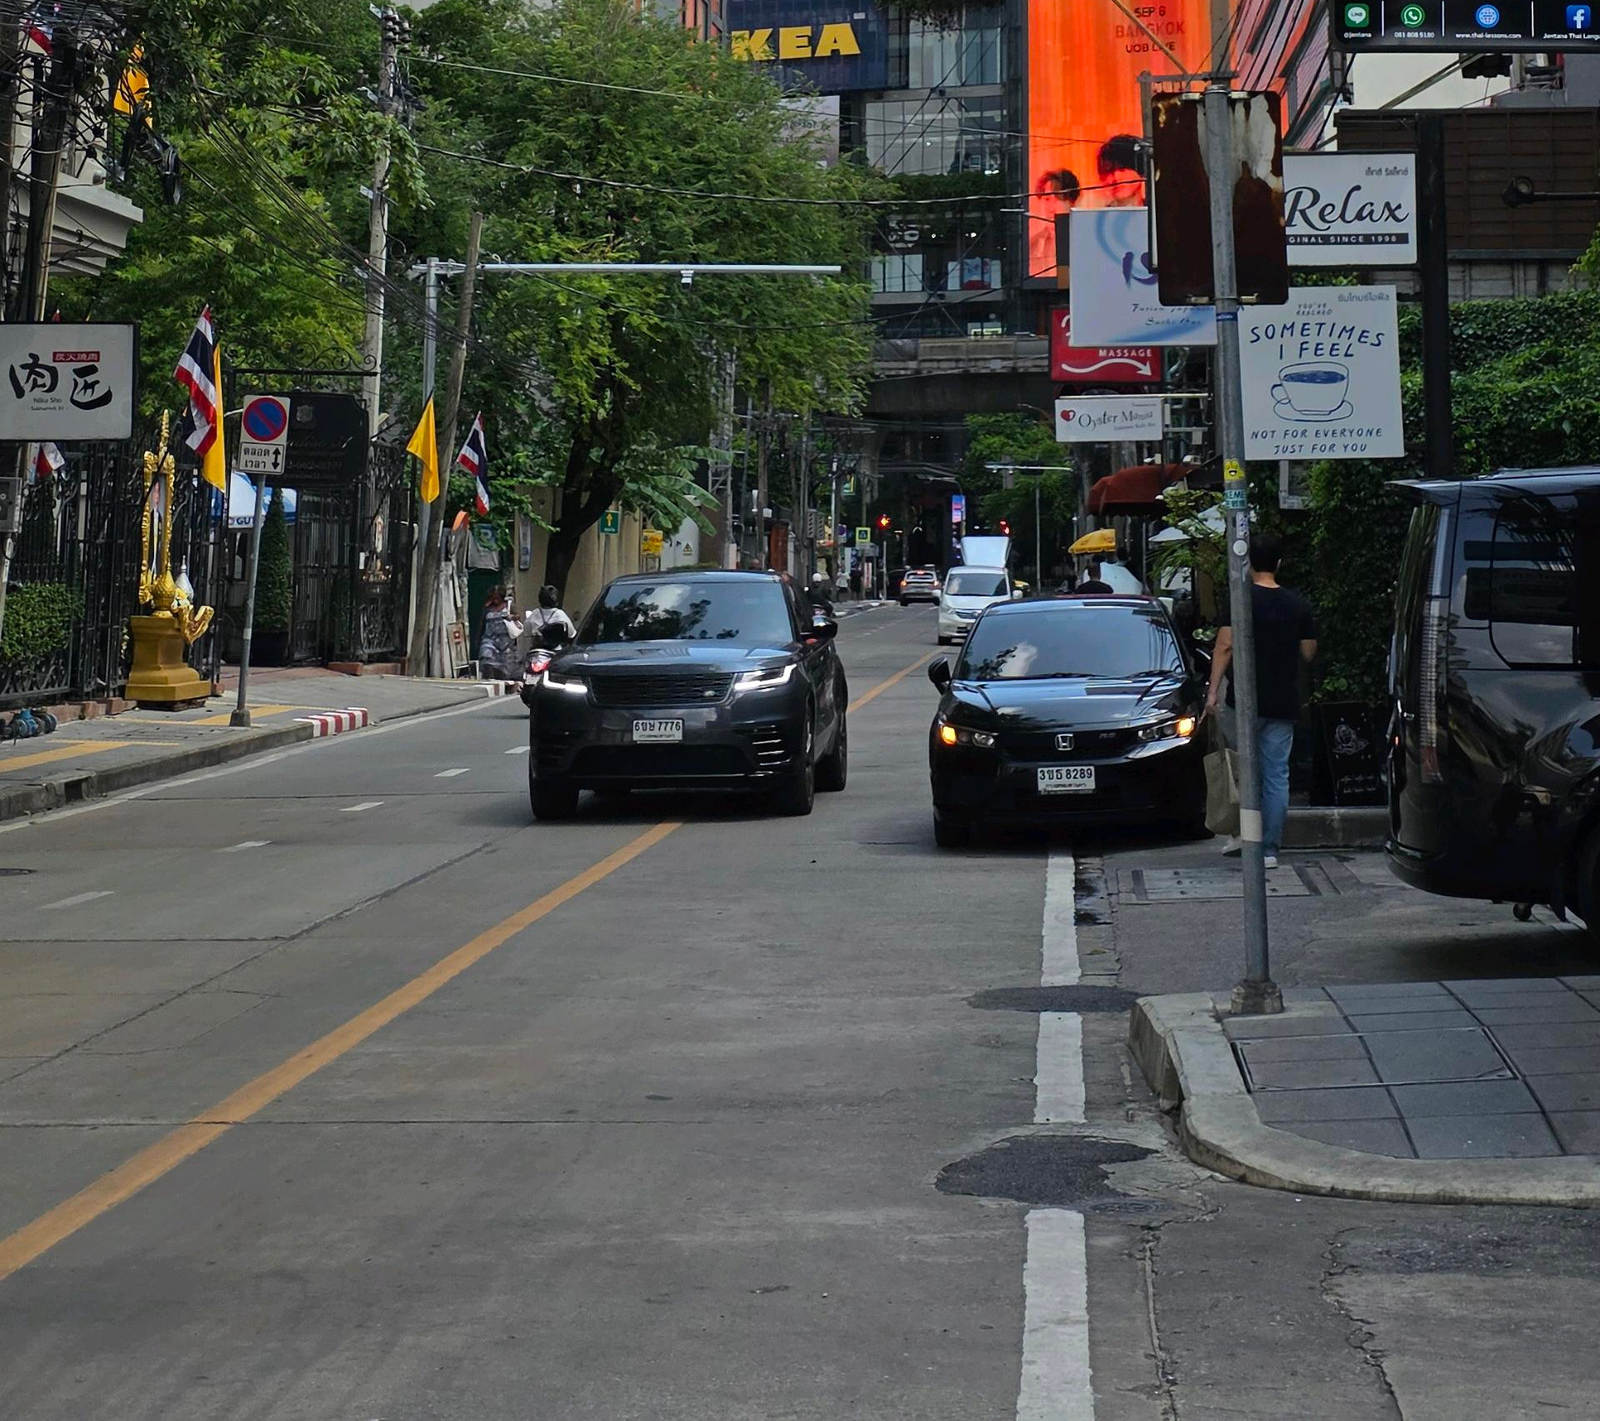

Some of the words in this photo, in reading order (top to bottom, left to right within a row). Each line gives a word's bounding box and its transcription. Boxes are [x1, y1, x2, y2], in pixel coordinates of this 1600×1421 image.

[1134, 6, 1155, 18] SEP
[1116, 20, 1185, 38] BANGKOK
[1125, 43, 1150, 53] UOB
[1152, 41, 1176, 52] LE
[1284, 184, 1410, 232] Relax
[1288, 236, 1323, 244] GINAL
[1371, 235, 1397, 243] 1998
[1250, 321, 1385, 347] SOMETIMES
[1098, 348, 1152, 358] MASSAGE
[1279, 344, 1284, 360] I
[1298, 341, 1355, 359] FEEL
[1078, 410, 1119, 432] Oyster
[1250, 429, 1277, 440] NOT
[1283, 429, 1308, 440] FOR
[1315, 427, 1383, 439] EVERYONE
[1274, 444, 1305, 455] JUST
[1311, 443, 1337, 454] FOR
[1343, 442, 1368, 453] YOU
[657, 721, 681, 732] 7776
[1065, 767, 1093, 780] 8289
